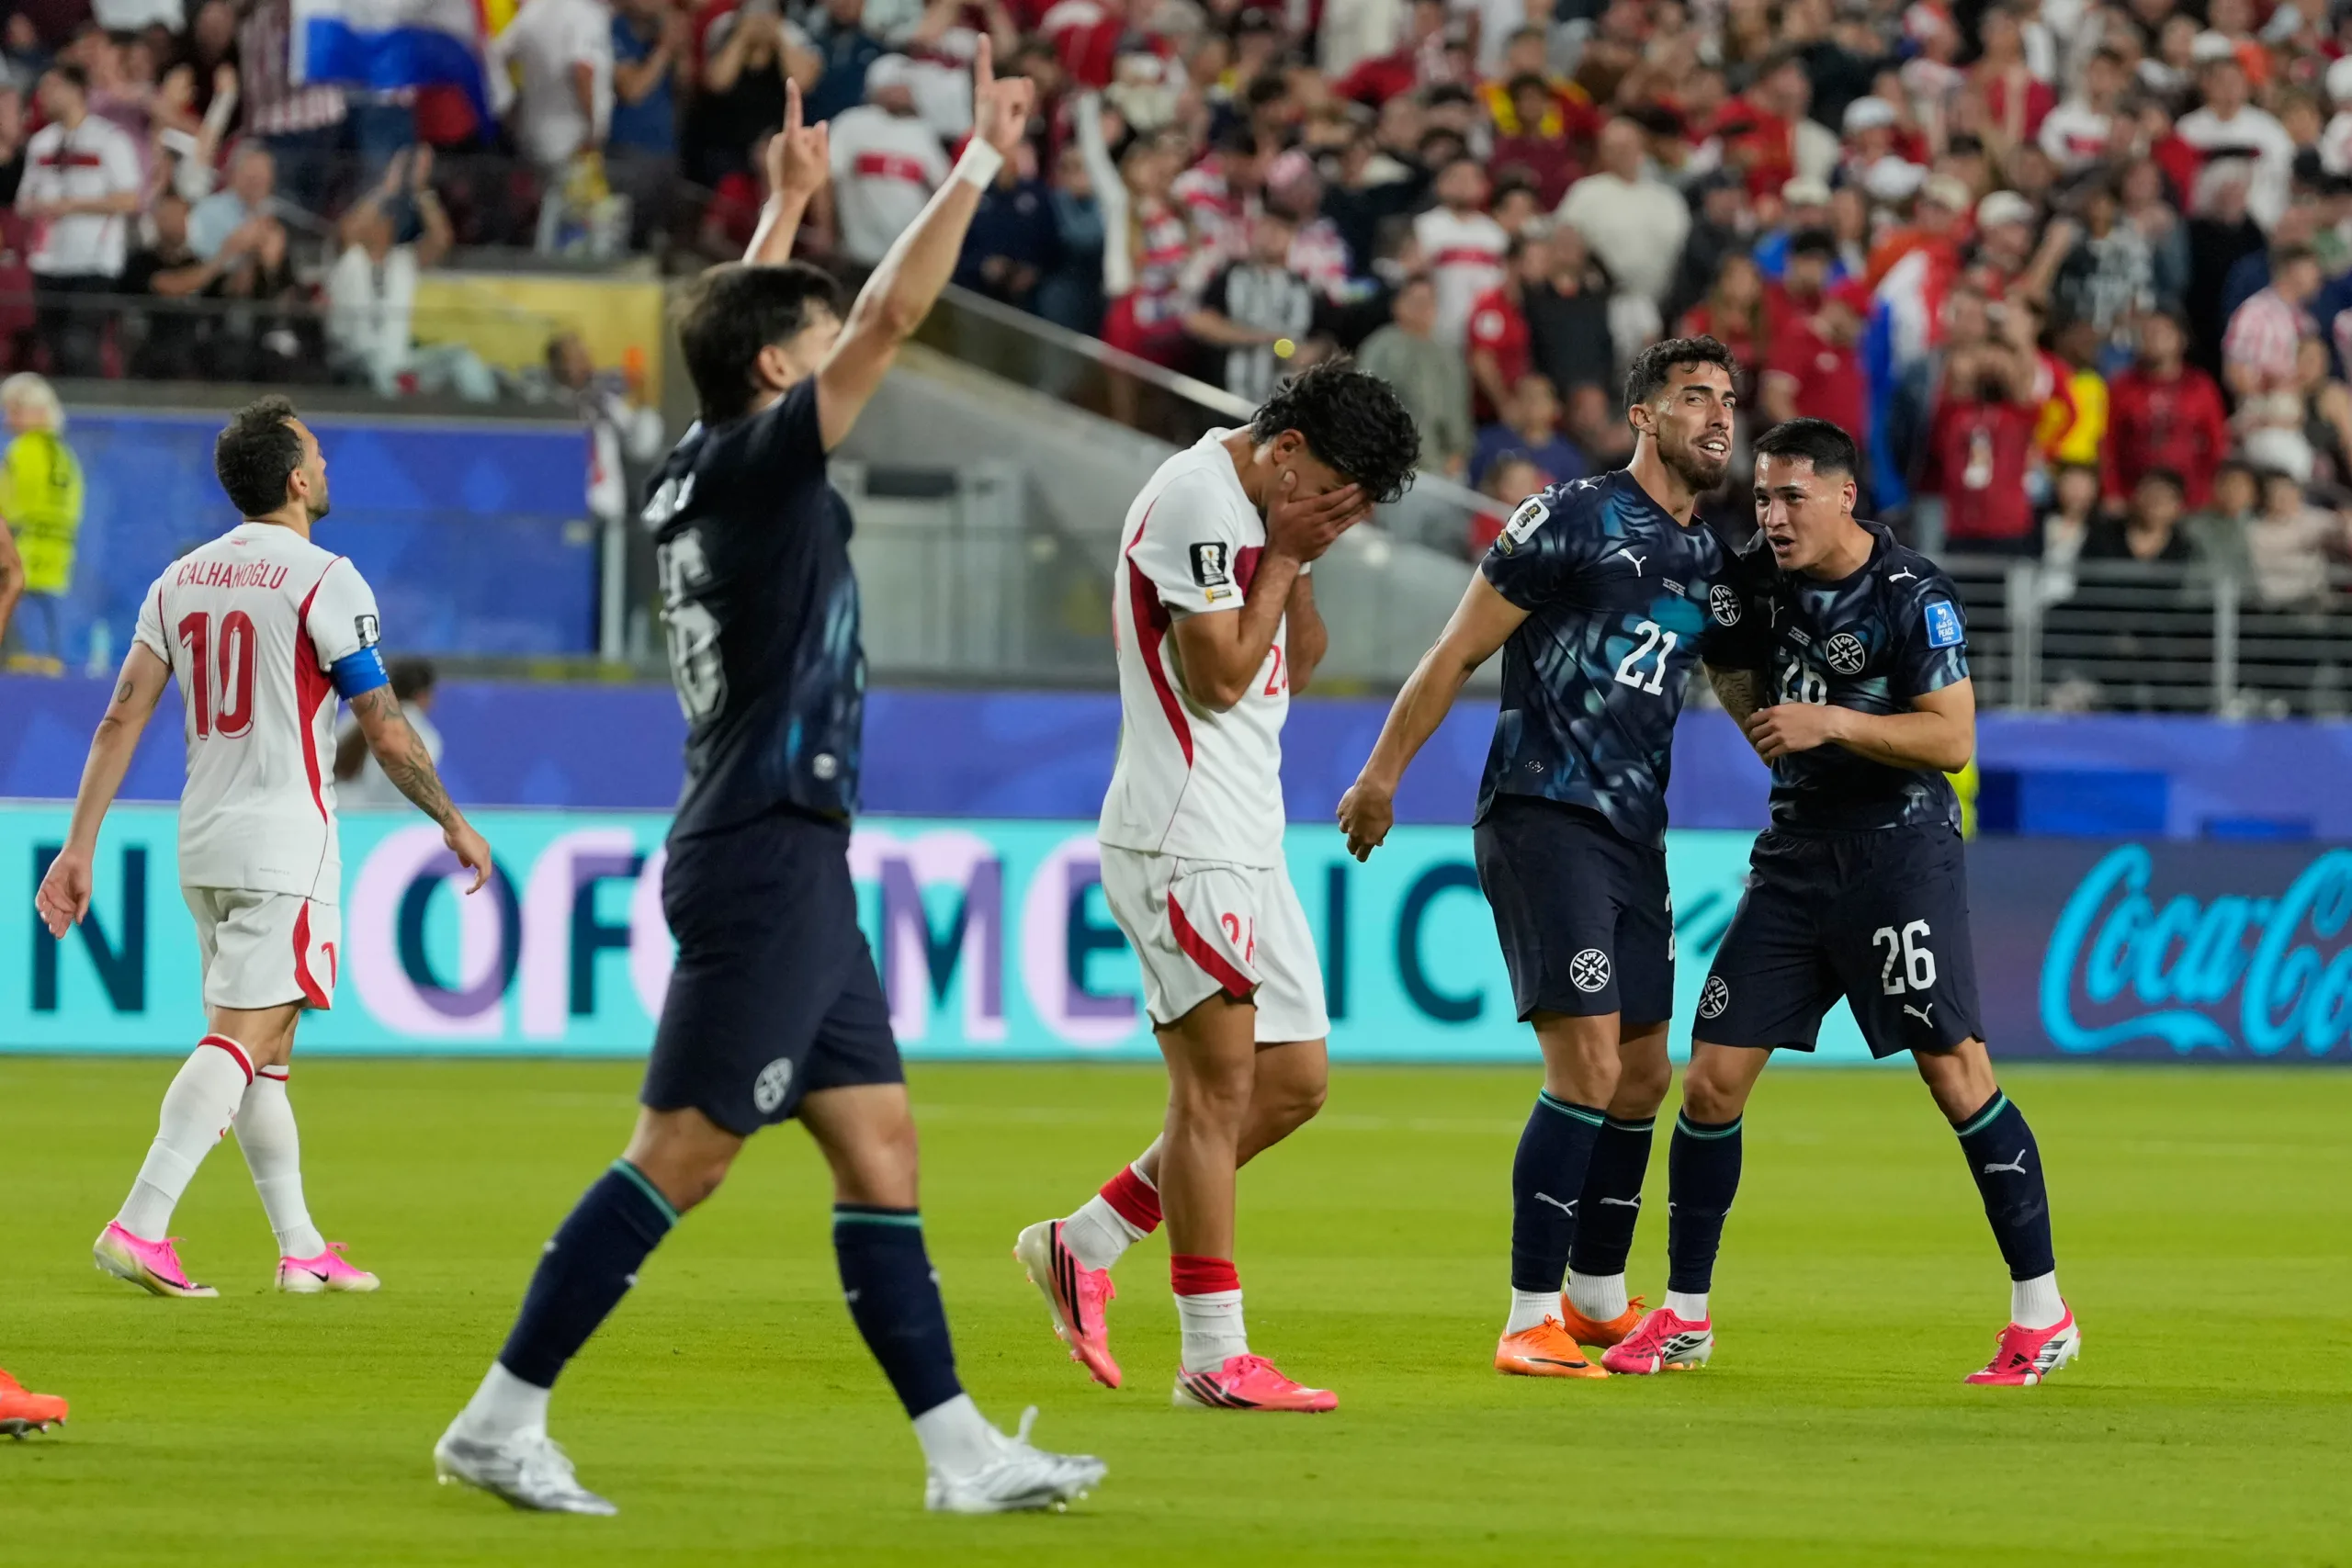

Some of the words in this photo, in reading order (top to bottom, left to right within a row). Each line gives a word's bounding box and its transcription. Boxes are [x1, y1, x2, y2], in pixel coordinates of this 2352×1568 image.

[1264, 645, 1288, 697] 2
[1614, 620, 1678, 696] 21
[1839, 637, 1854, 646] APF
[178, 610, 257, 741] 10
[33, 842, 147, 1014] N
[1583, 952, 1598, 961] APF
[1872, 919, 1937, 996] 26
[321, 942, 337, 990] 1
